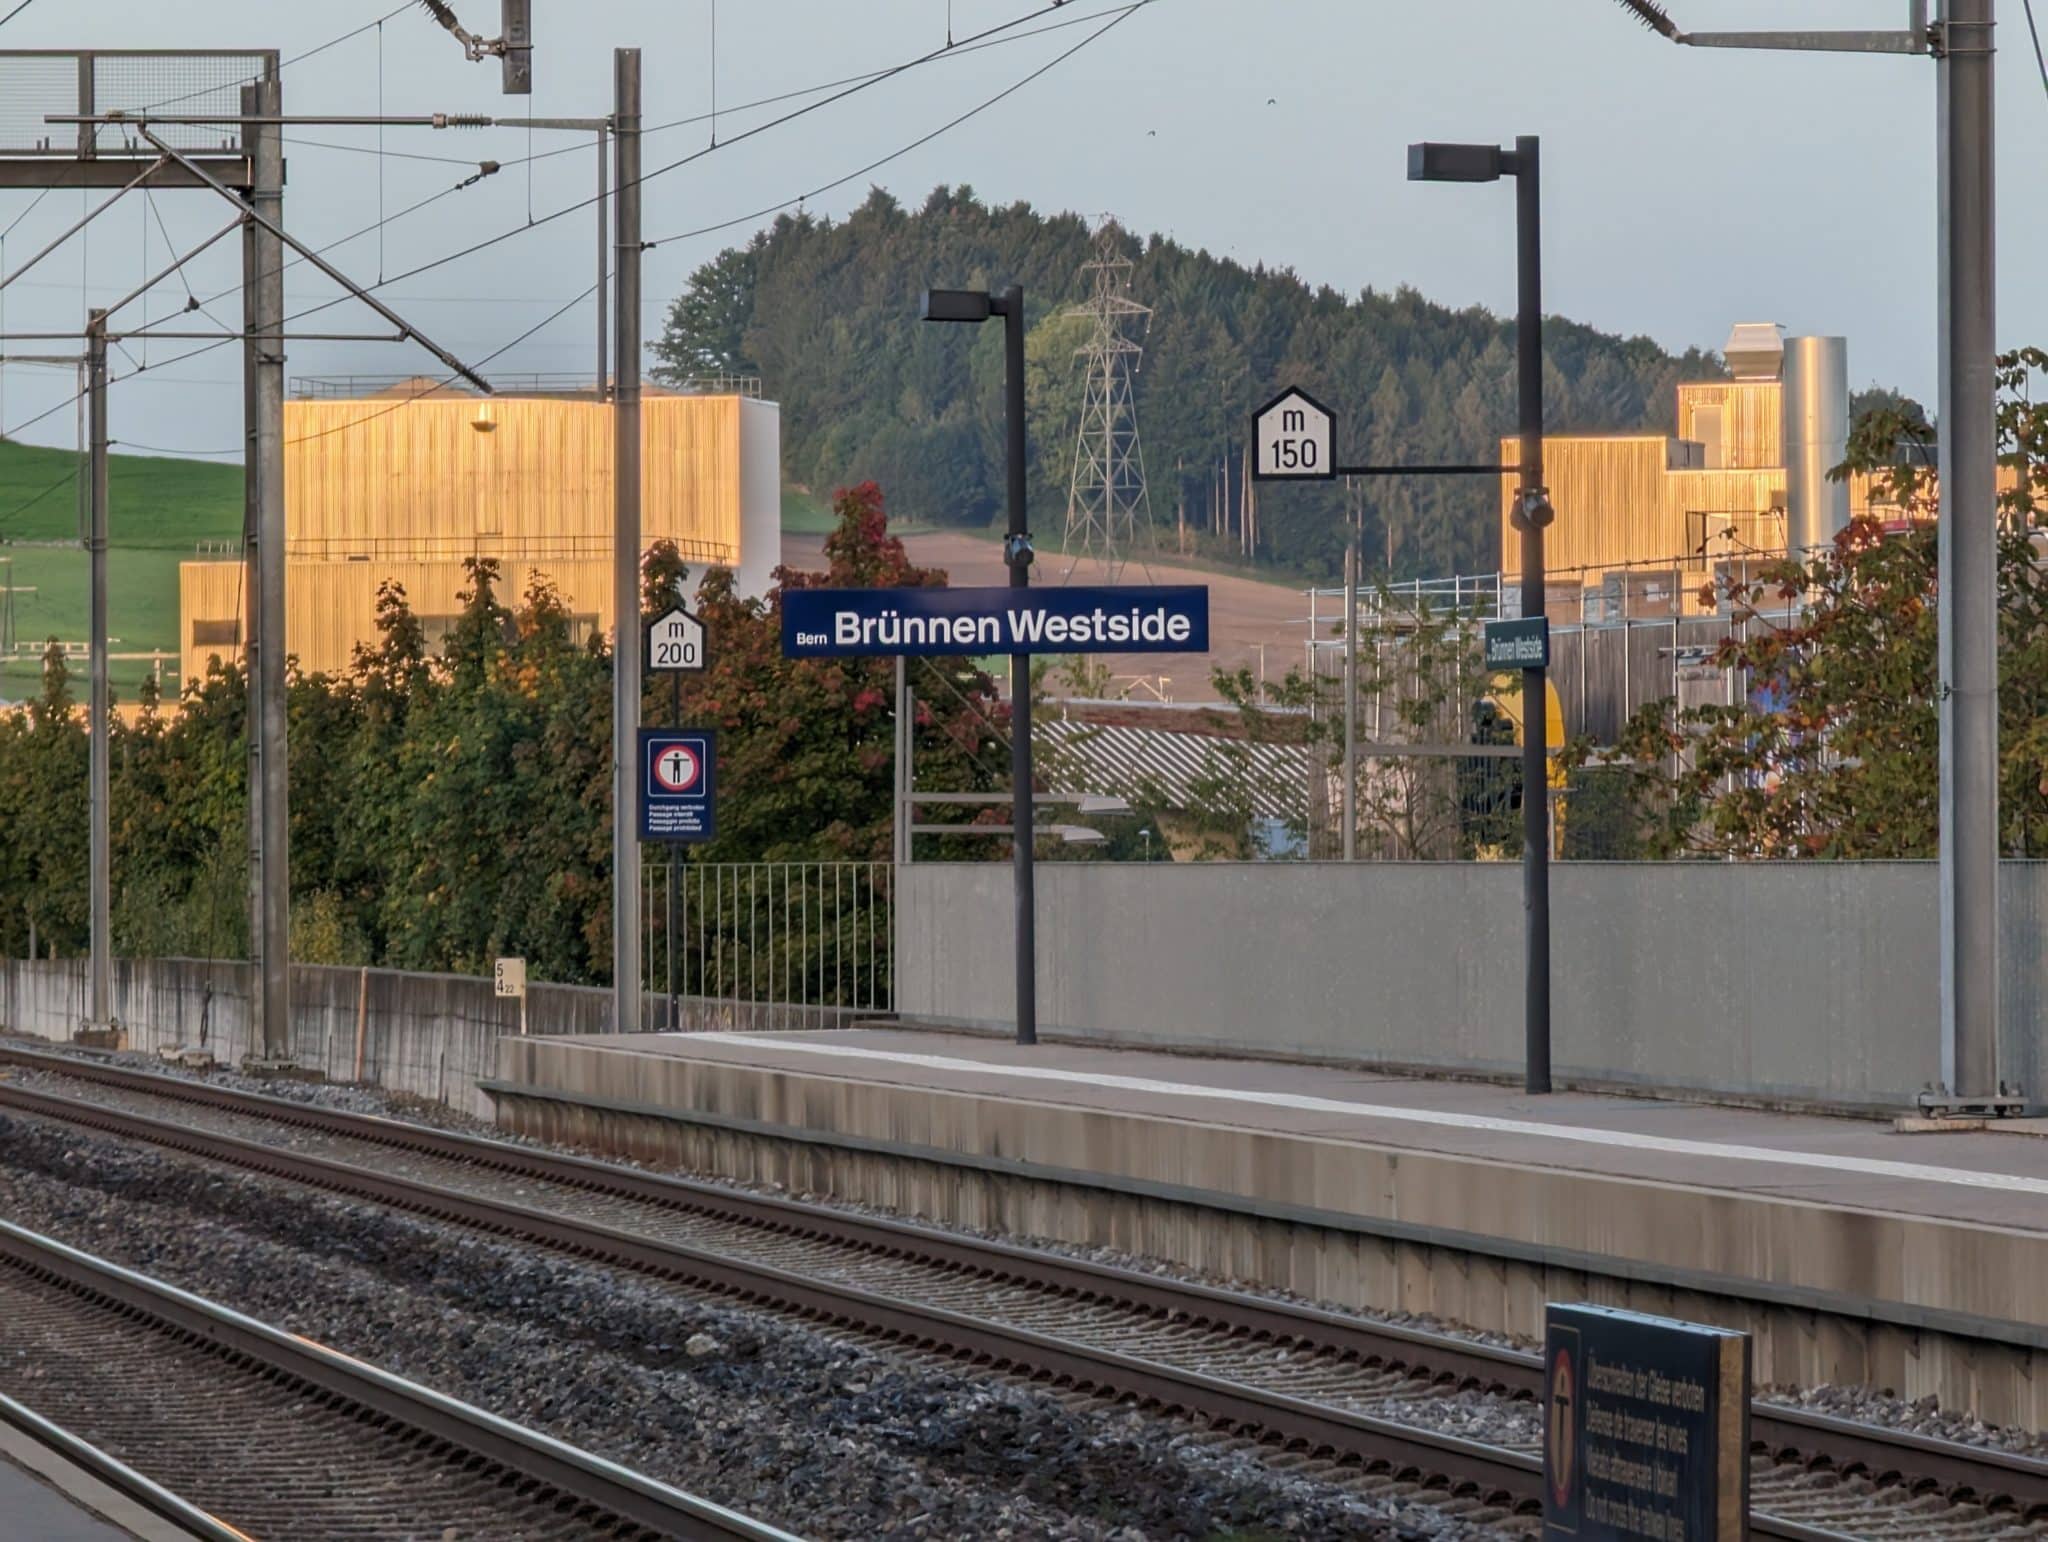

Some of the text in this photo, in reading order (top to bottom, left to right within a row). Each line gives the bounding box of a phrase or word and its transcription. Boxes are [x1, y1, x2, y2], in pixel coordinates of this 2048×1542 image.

[1283, 410, 1304, 432] m
[1271, 438, 1317, 469] 150
[668, 622, 684, 638] m
[796, 607, 1191, 646] Bern Brünnen Westside
[657, 642, 695, 664] 200
[496, 963, 504, 977] 5
[496, 979, 504, 993] 4
